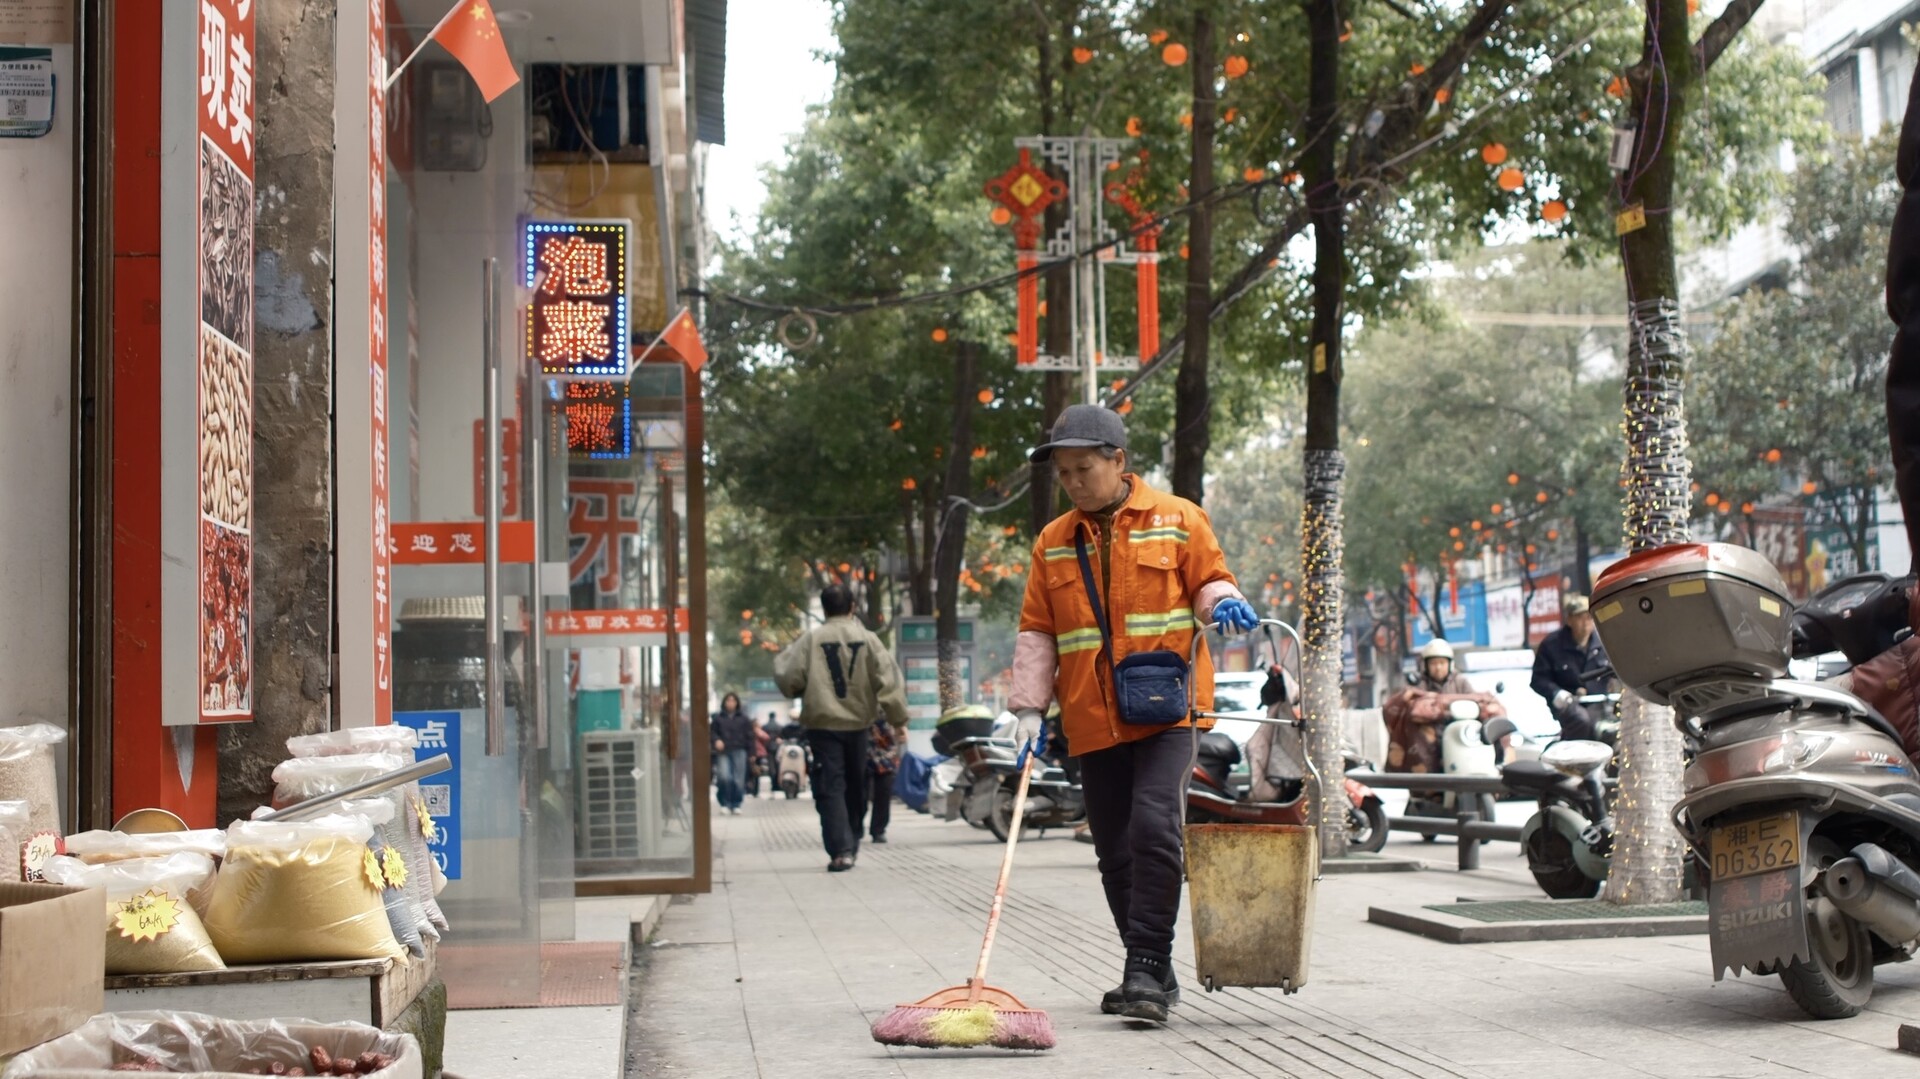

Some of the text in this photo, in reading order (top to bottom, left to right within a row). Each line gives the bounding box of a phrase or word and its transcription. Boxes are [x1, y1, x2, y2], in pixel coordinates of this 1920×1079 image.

[540, 236, 612, 363] 泡菜
[820, 642, 865, 699] V
[1715, 839, 1794, 878] DG362
[1718, 901, 1793, 931] SUZUKI
